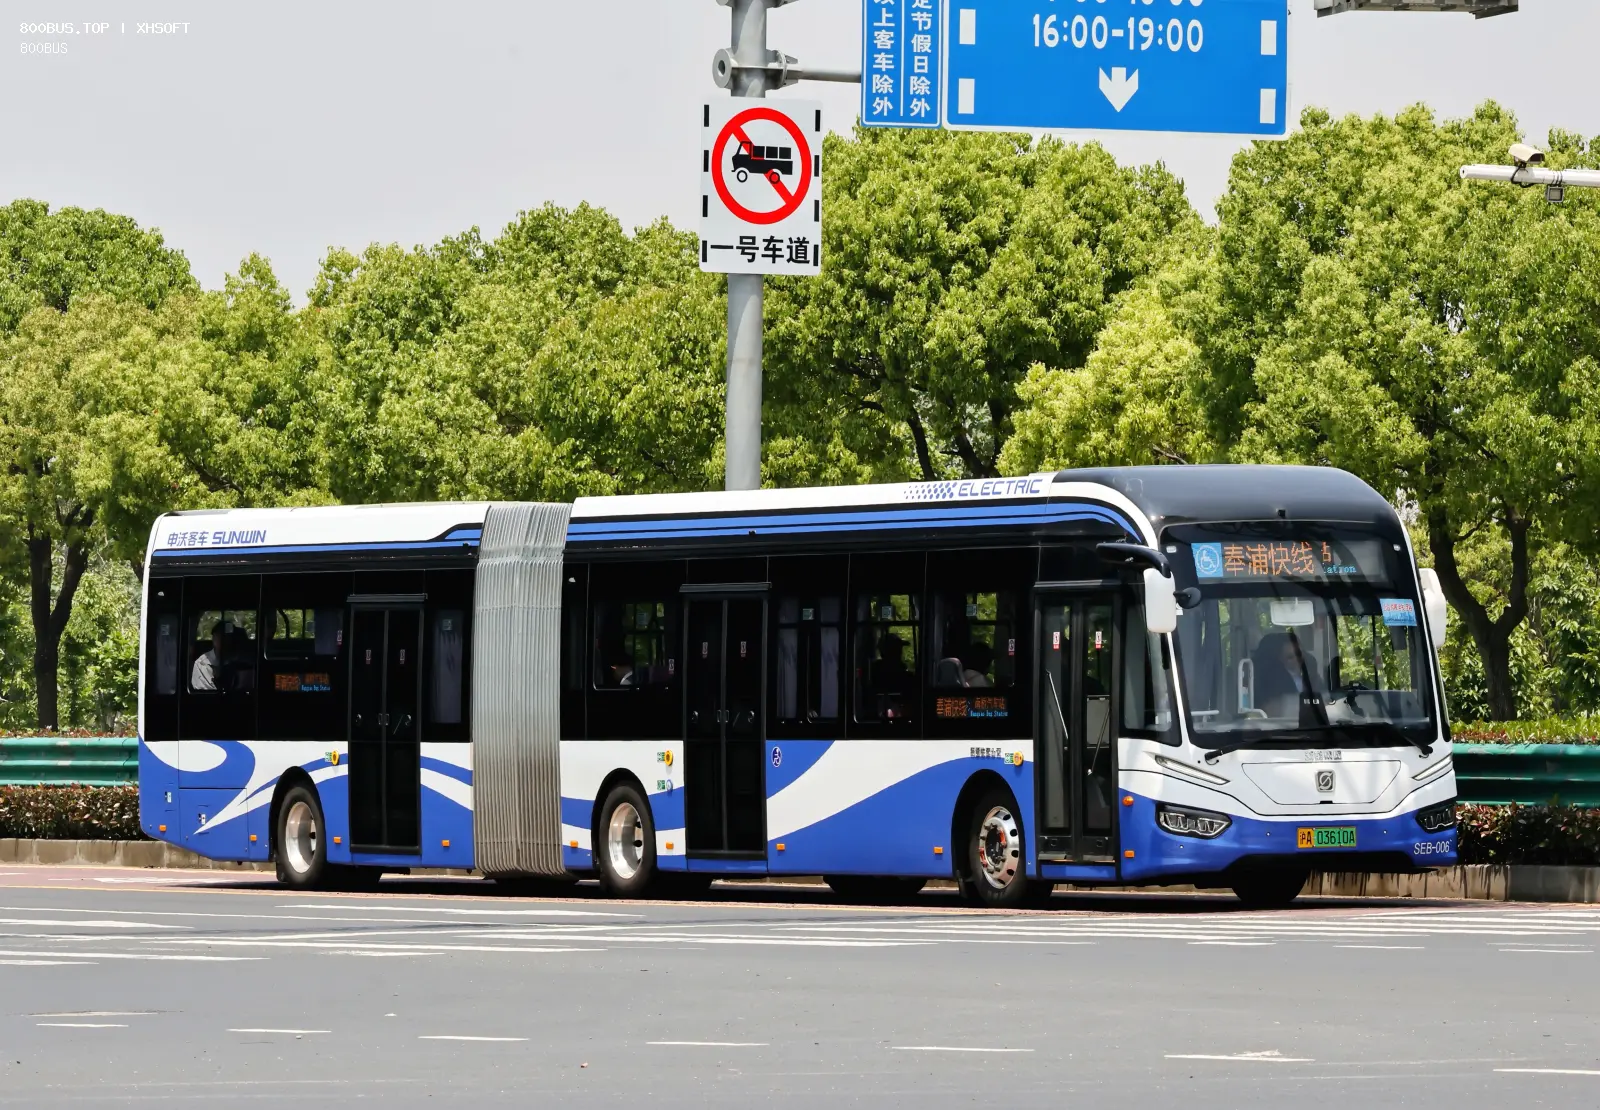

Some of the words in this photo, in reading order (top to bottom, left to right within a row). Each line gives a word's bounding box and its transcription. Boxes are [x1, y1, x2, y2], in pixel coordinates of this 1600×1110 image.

[1032, 13, 1204, 53] 16:00-19:00
[872, 0, 896, 117] 上客车除外
[710, 235, 811, 264] 一号车道
[958, 478, 1043, 497] ELECTRIC
[167, 530, 209, 547] 申沃客车
[211, 529, 267, 545] SUNWIN
[1223, 541, 1315, 577] 奉浦快线
[1413, 840, 1450, 855] SEB-006
